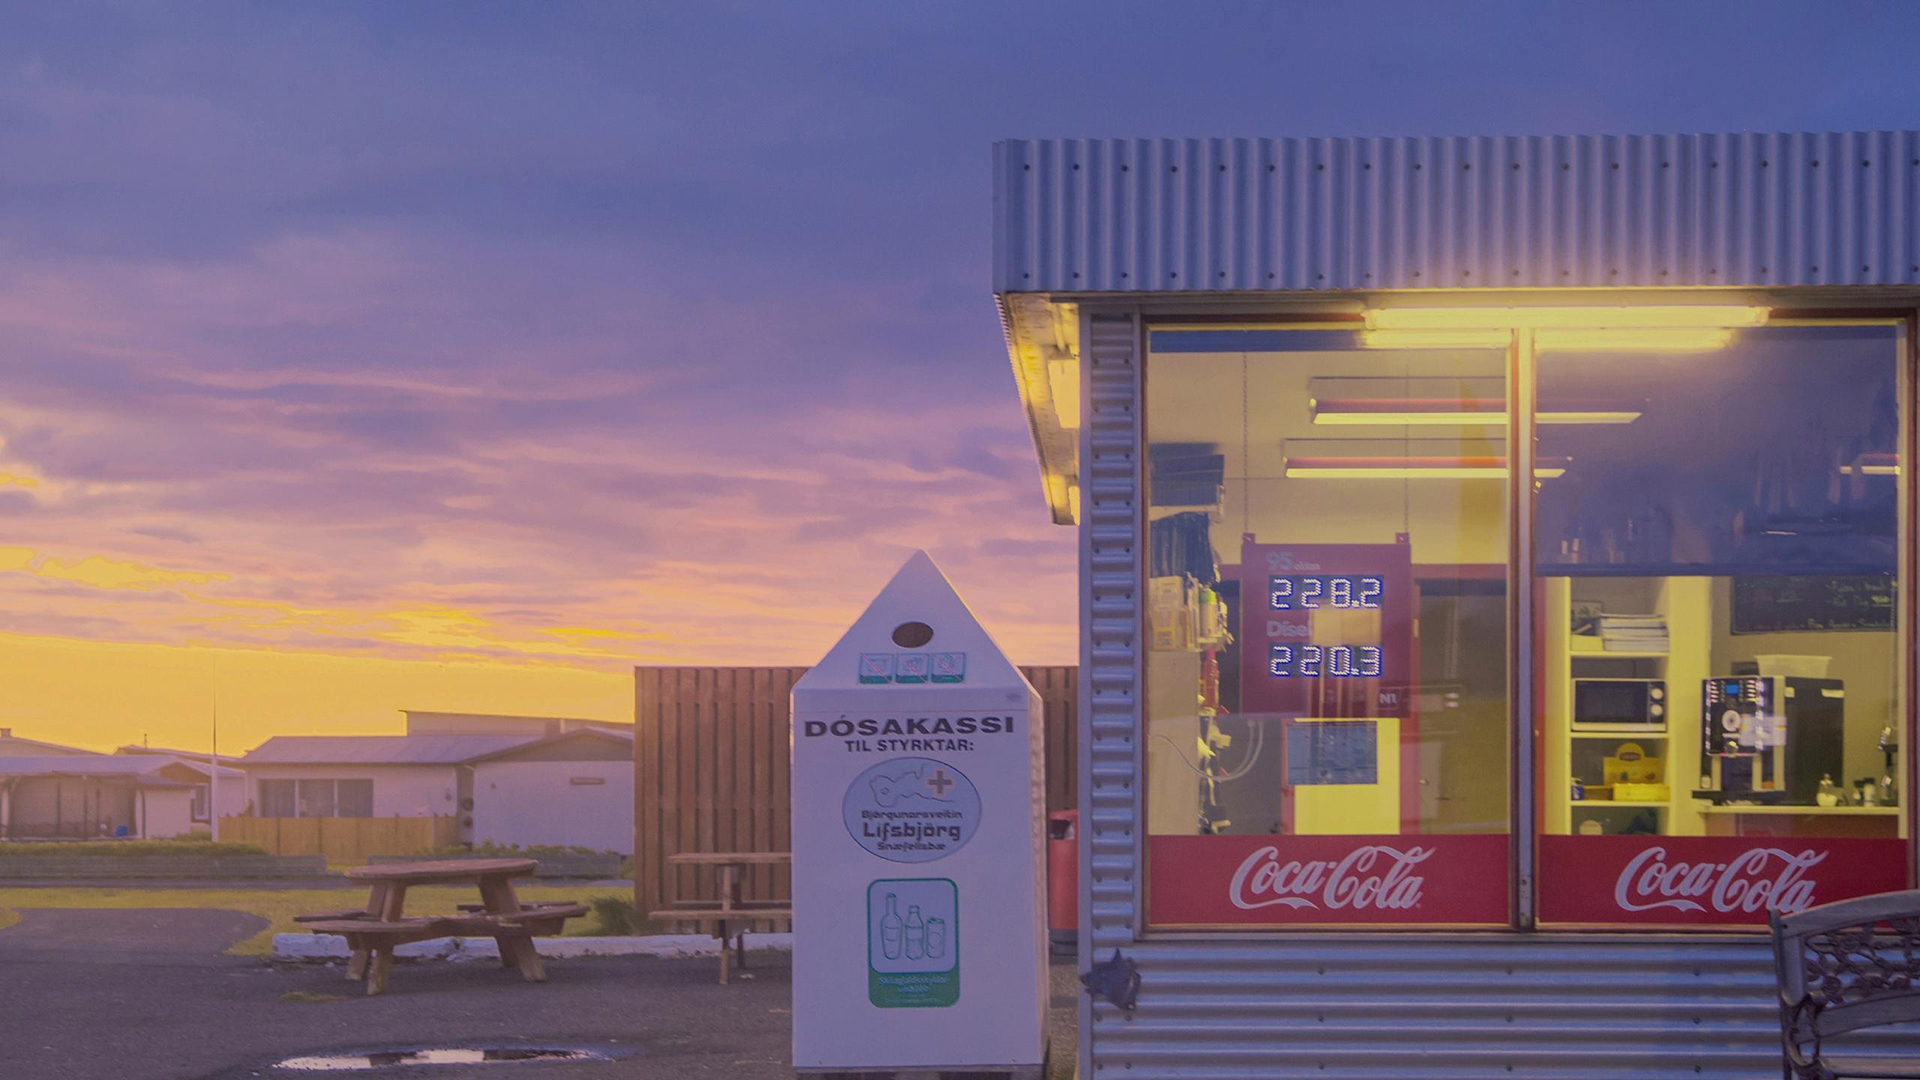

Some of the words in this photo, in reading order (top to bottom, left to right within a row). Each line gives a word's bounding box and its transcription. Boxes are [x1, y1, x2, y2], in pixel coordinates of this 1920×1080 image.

[1266, 552, 1294, 570] 95
[1271, 578, 1382, 609] 228.2
[1270, 646, 1381, 677] 220.3
[804, 715, 1015, 737] DÓSAKASSI
[845, 740, 872, 752] TIL
[877, 739, 975, 751] STYRKTAR:
[863, 822, 961, 842] Lifsbjörg
[1229, 846, 1438, 910] Coca-Cola
[1615, 846, 1829, 913] Coca-Cola
